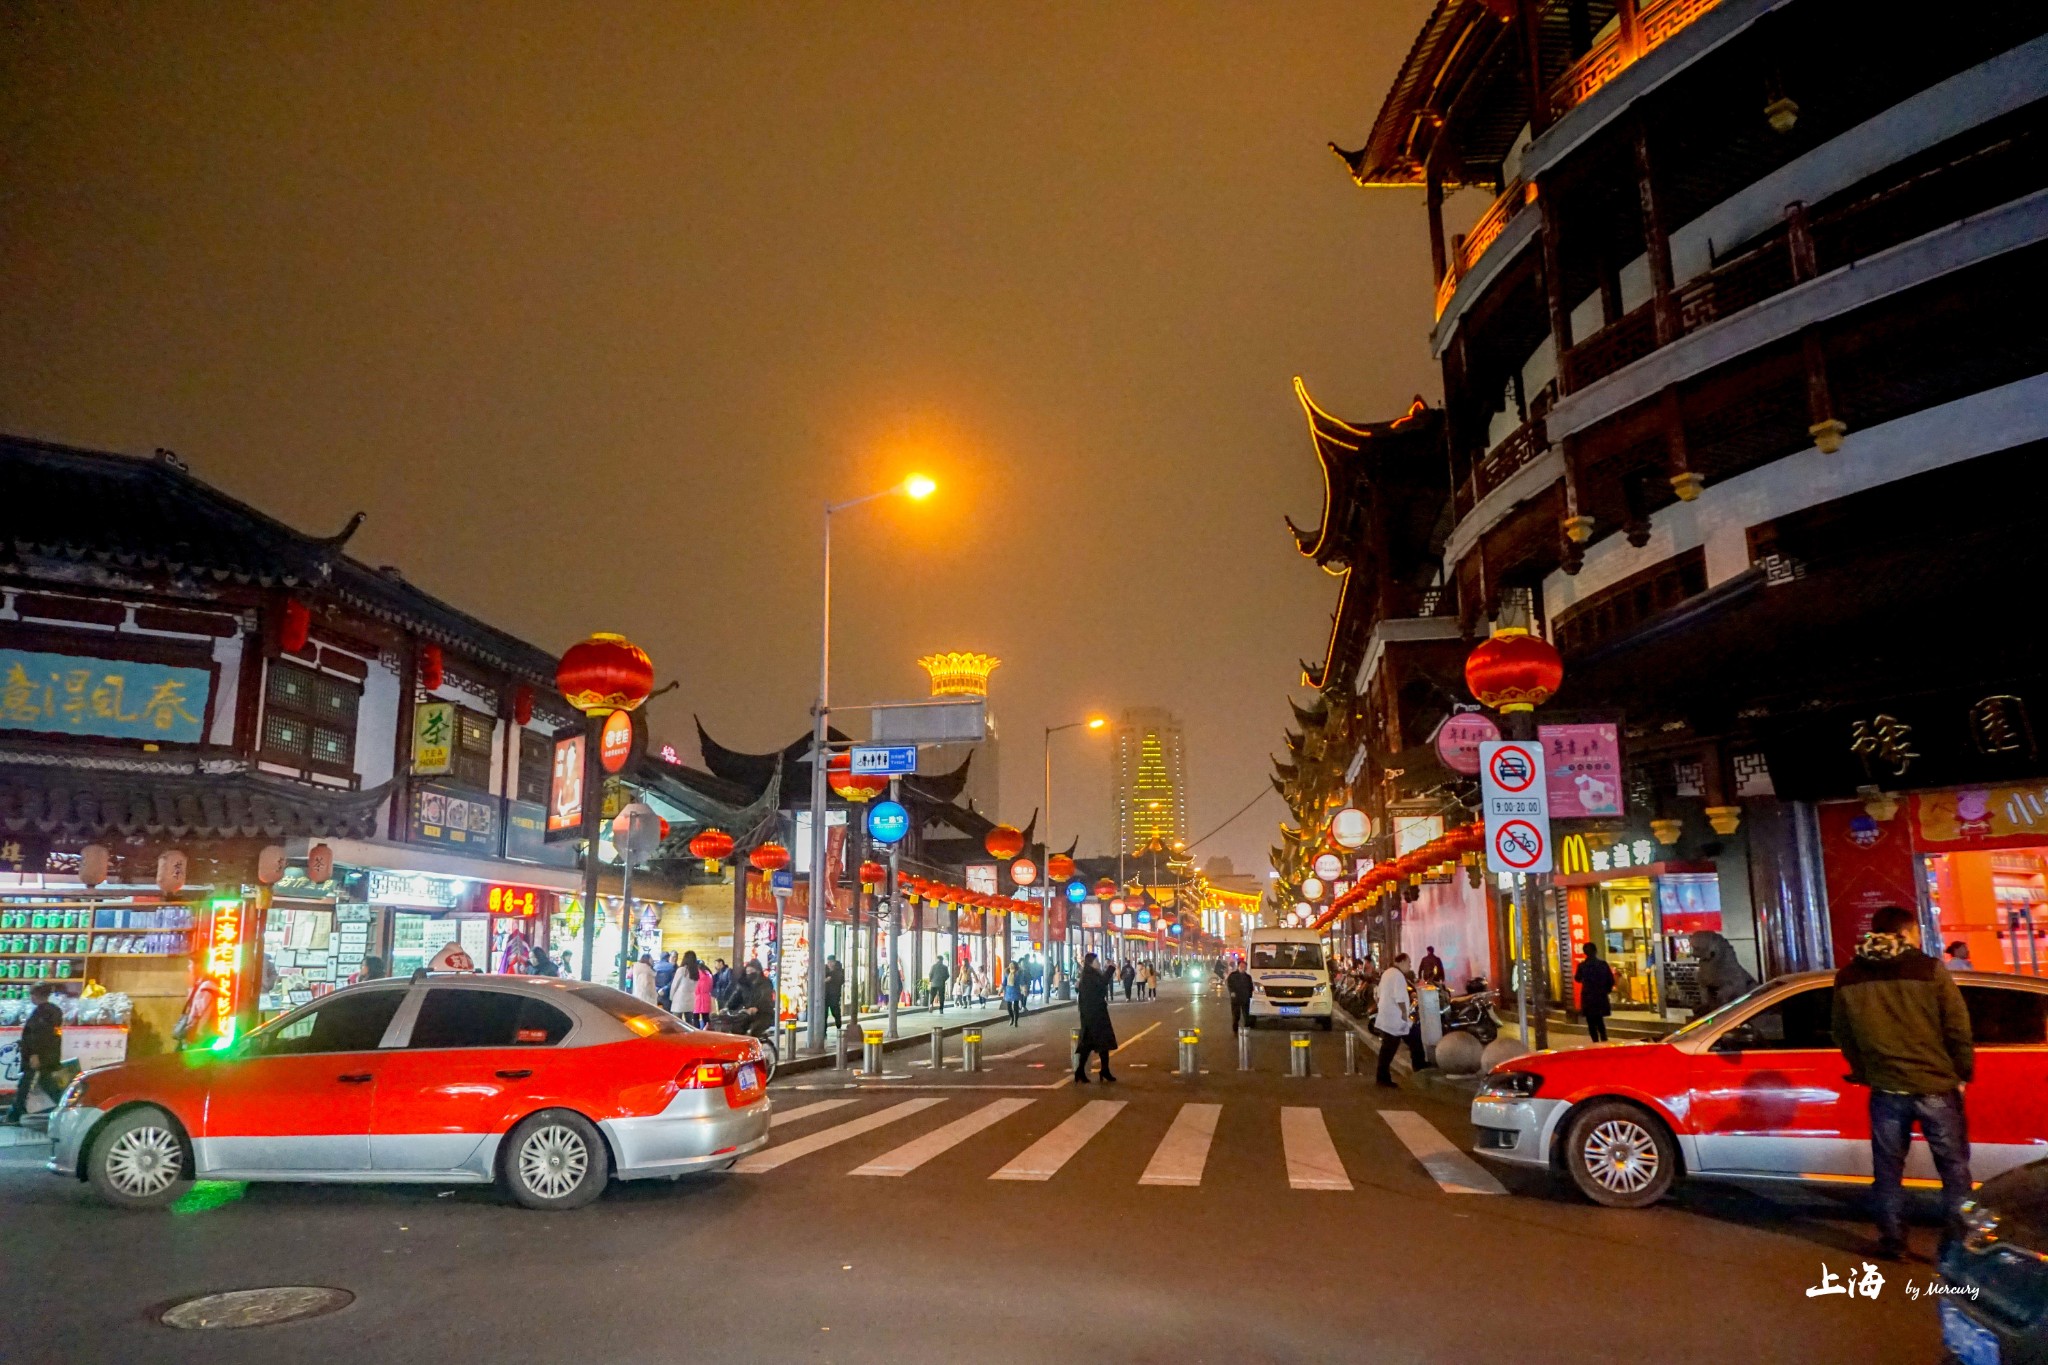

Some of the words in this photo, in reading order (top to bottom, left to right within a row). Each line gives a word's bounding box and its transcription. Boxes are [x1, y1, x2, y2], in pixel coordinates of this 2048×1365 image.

[421, 710, 450, 745] 茶
[424, 749, 443, 757] TEA
[420, 757, 446, 766] HOUSE
[1592, 839, 1650, 871] 麦当劳
[314, 856, 324, 872] 茶
